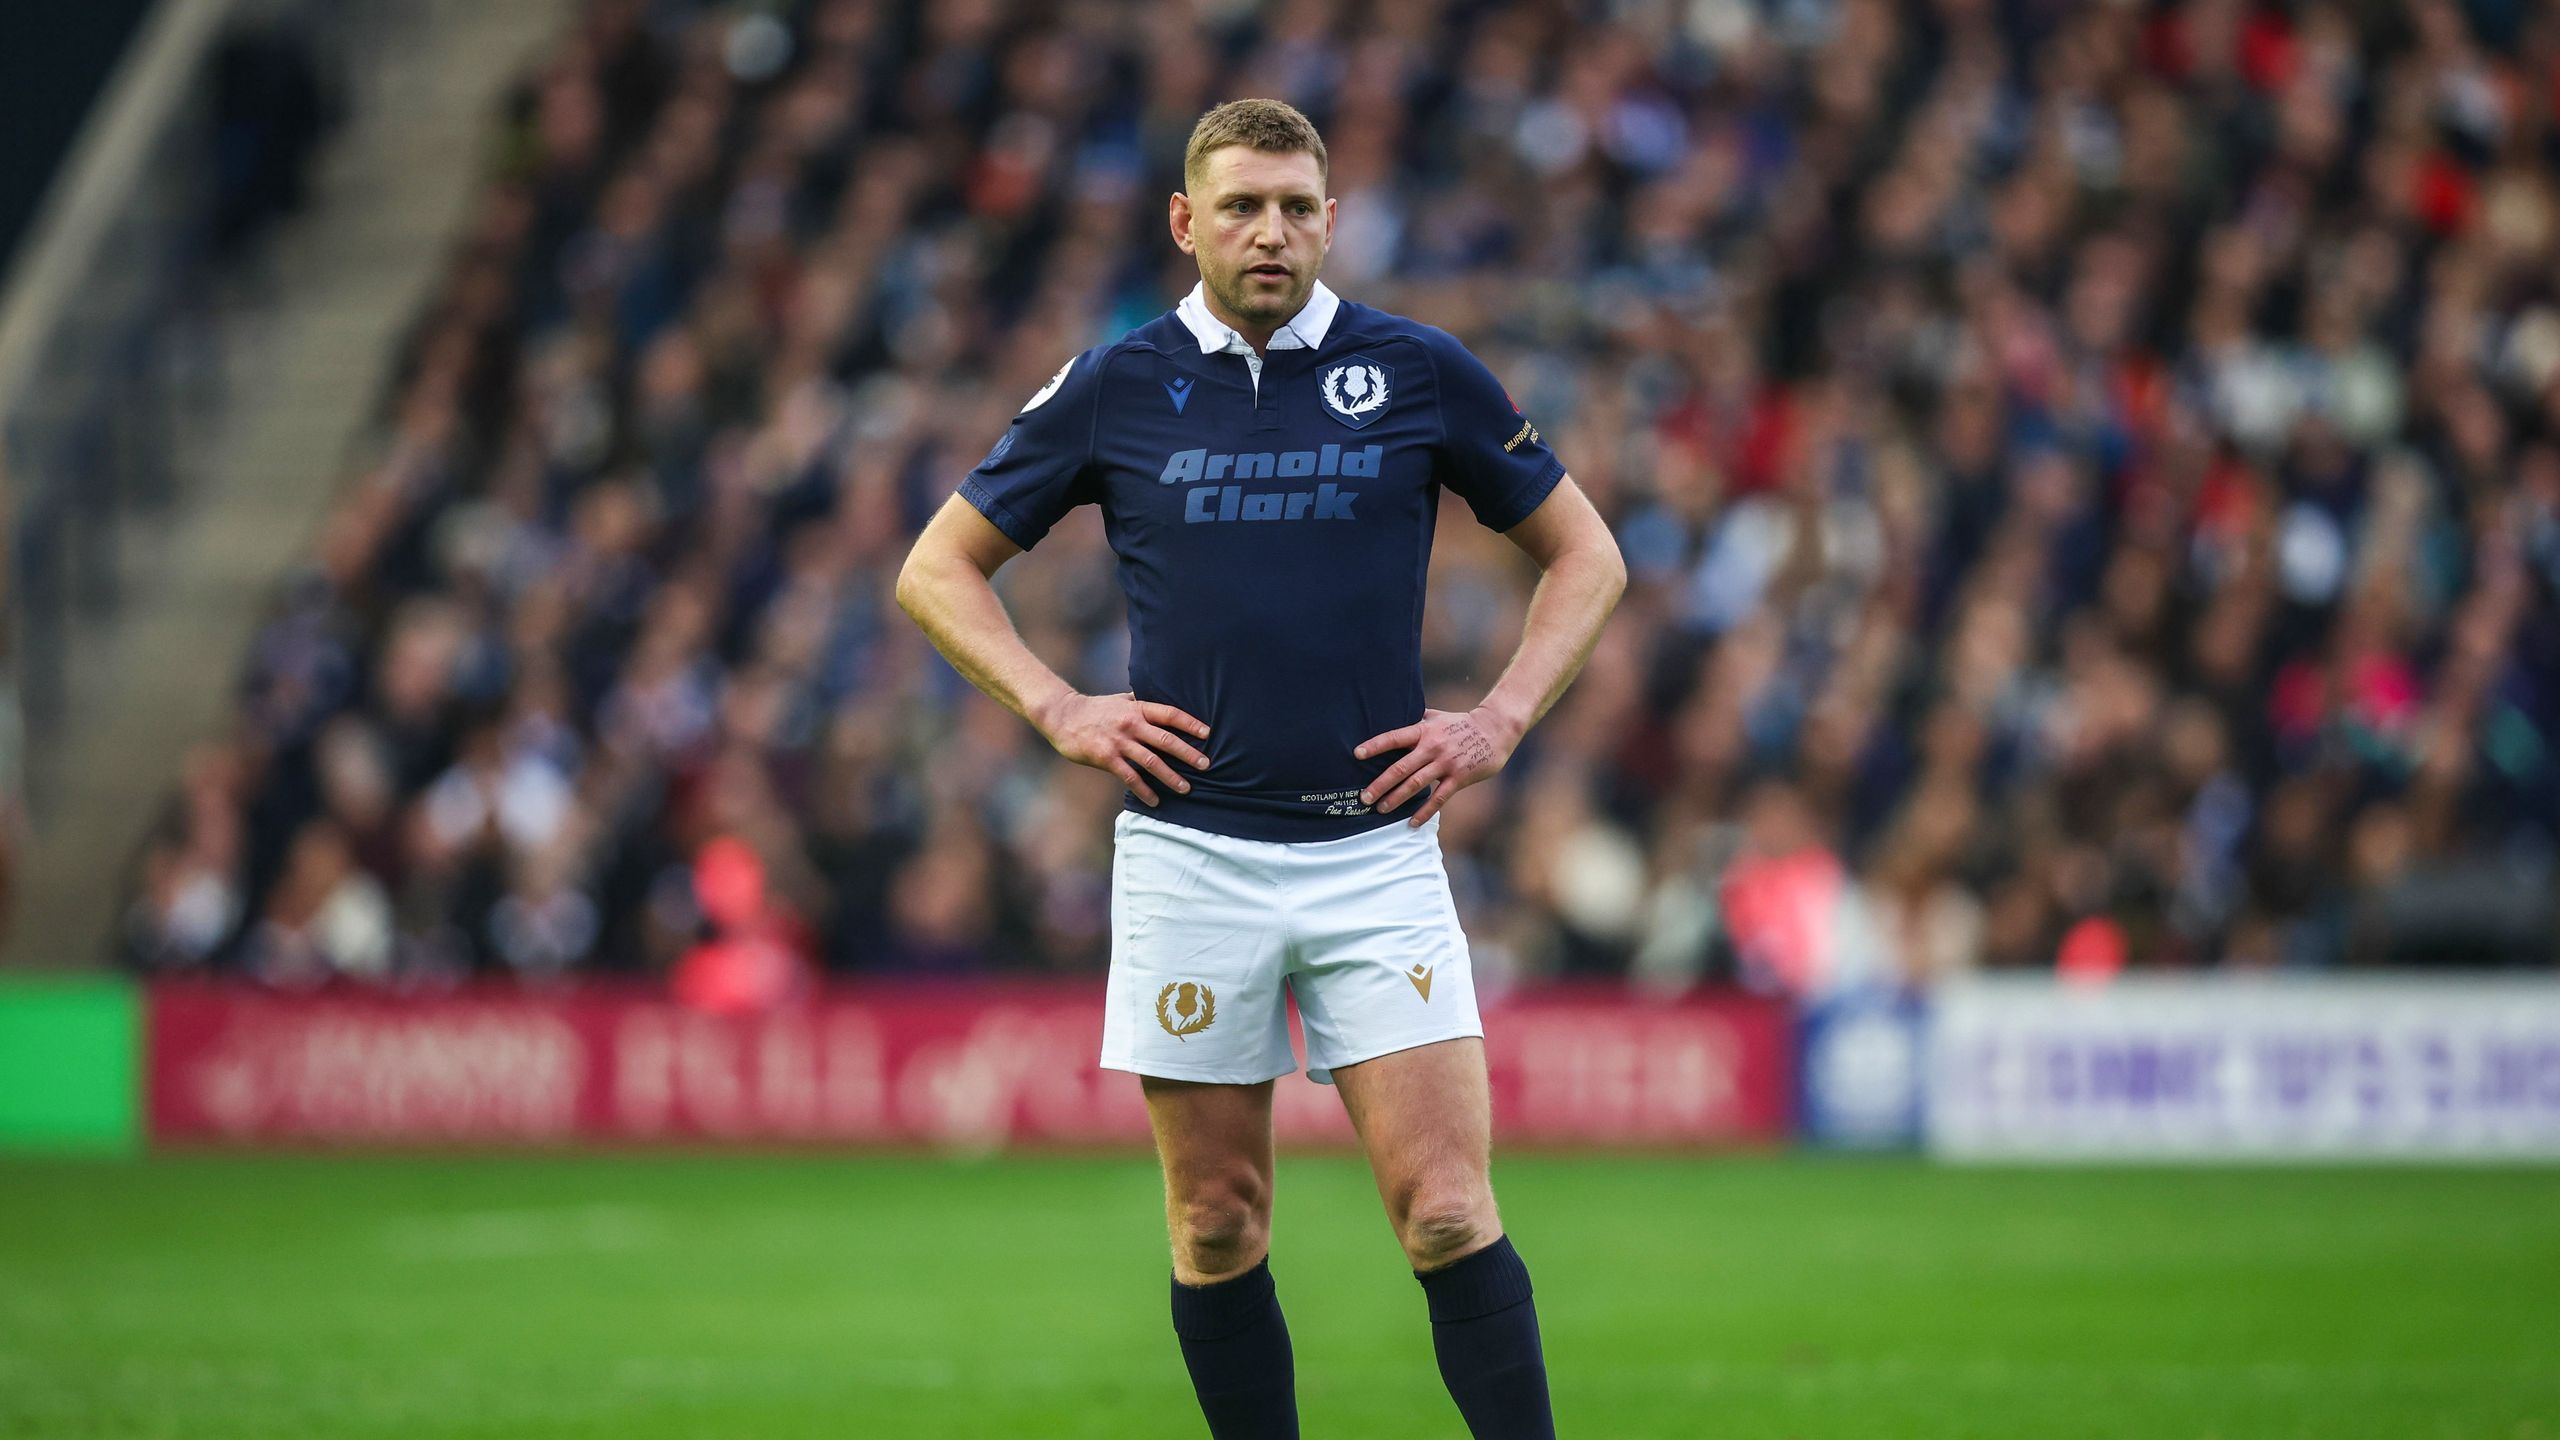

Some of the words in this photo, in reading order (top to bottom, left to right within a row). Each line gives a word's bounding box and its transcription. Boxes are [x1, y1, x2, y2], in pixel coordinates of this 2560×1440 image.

[1159, 443, 1383, 485] Arnold
[1184, 483, 1359, 523] Clark
[1301, 792, 1338, 802] SCOTLAND
[1345, 789, 1360, 798] NEW
